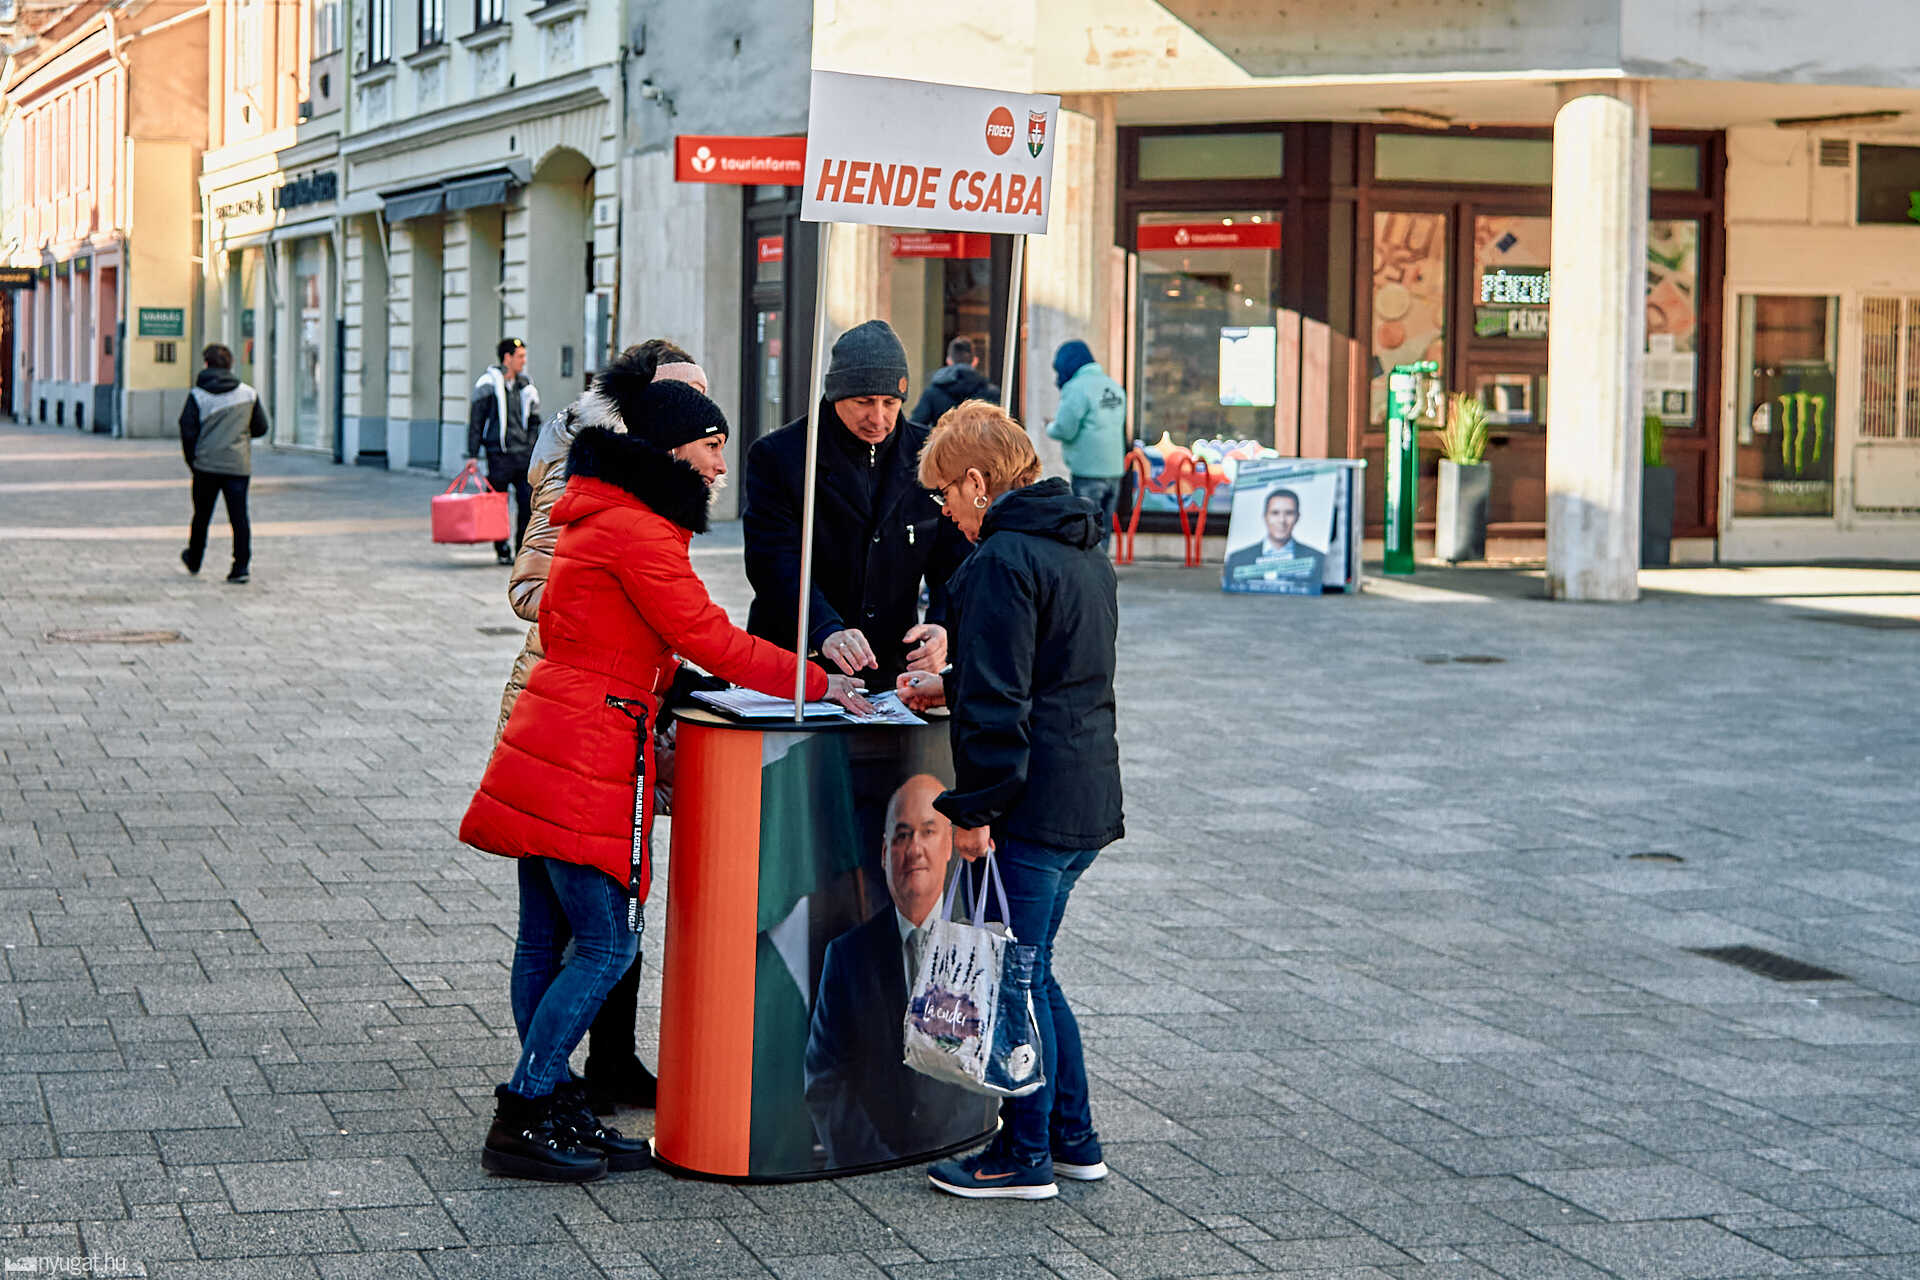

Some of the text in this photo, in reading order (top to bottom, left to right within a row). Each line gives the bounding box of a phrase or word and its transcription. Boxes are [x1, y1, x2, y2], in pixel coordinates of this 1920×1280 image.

[987, 125, 1013, 138] FIDESZ
[721, 156, 801, 171] tourinform
[816, 159, 1043, 216] HENDE CSABA
[632, 775, 644, 865] HUNGARIAN LEGENDS
